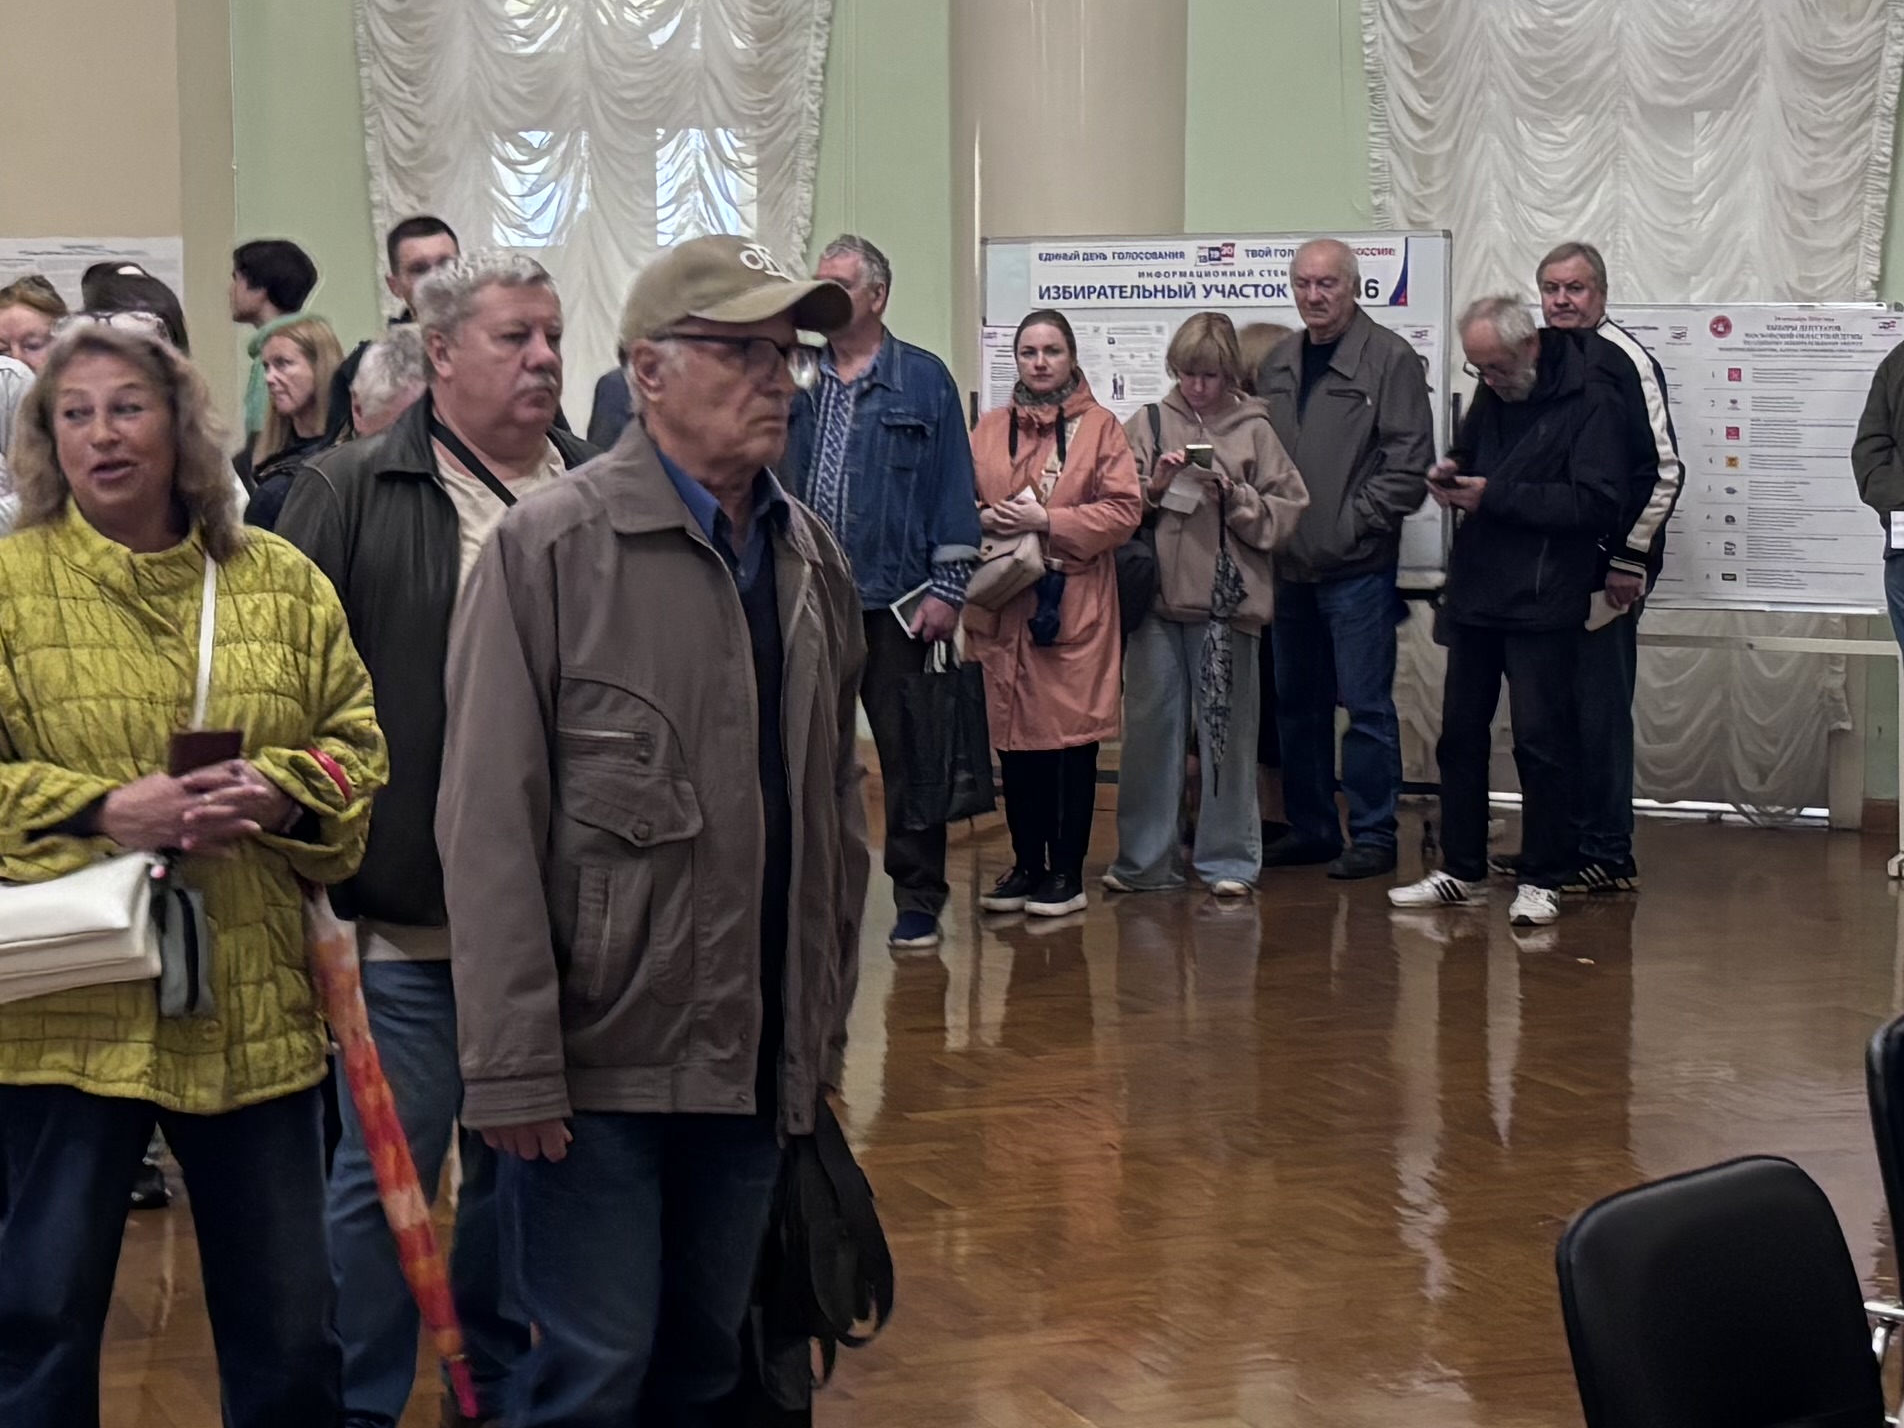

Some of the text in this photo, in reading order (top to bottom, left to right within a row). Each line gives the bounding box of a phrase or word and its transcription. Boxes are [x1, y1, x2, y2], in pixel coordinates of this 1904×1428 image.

[1038, 250, 1186, 262] ЕДИНЫЙ ДЕНЬ ГОЛОСОВАНИЯ
[1244, 246, 1272, 259] ТВОЙ
[1274, 248, 1295, 259] ГОЛ
[1137, 268, 1288, 279] ИНФОРМАЦИОННЫЙ СТЕН
[1038, 281, 1196, 301] ИЗБИРАТЕЛЬНЫЙ
[1202, 283, 1288, 299] УЧАСТОК
